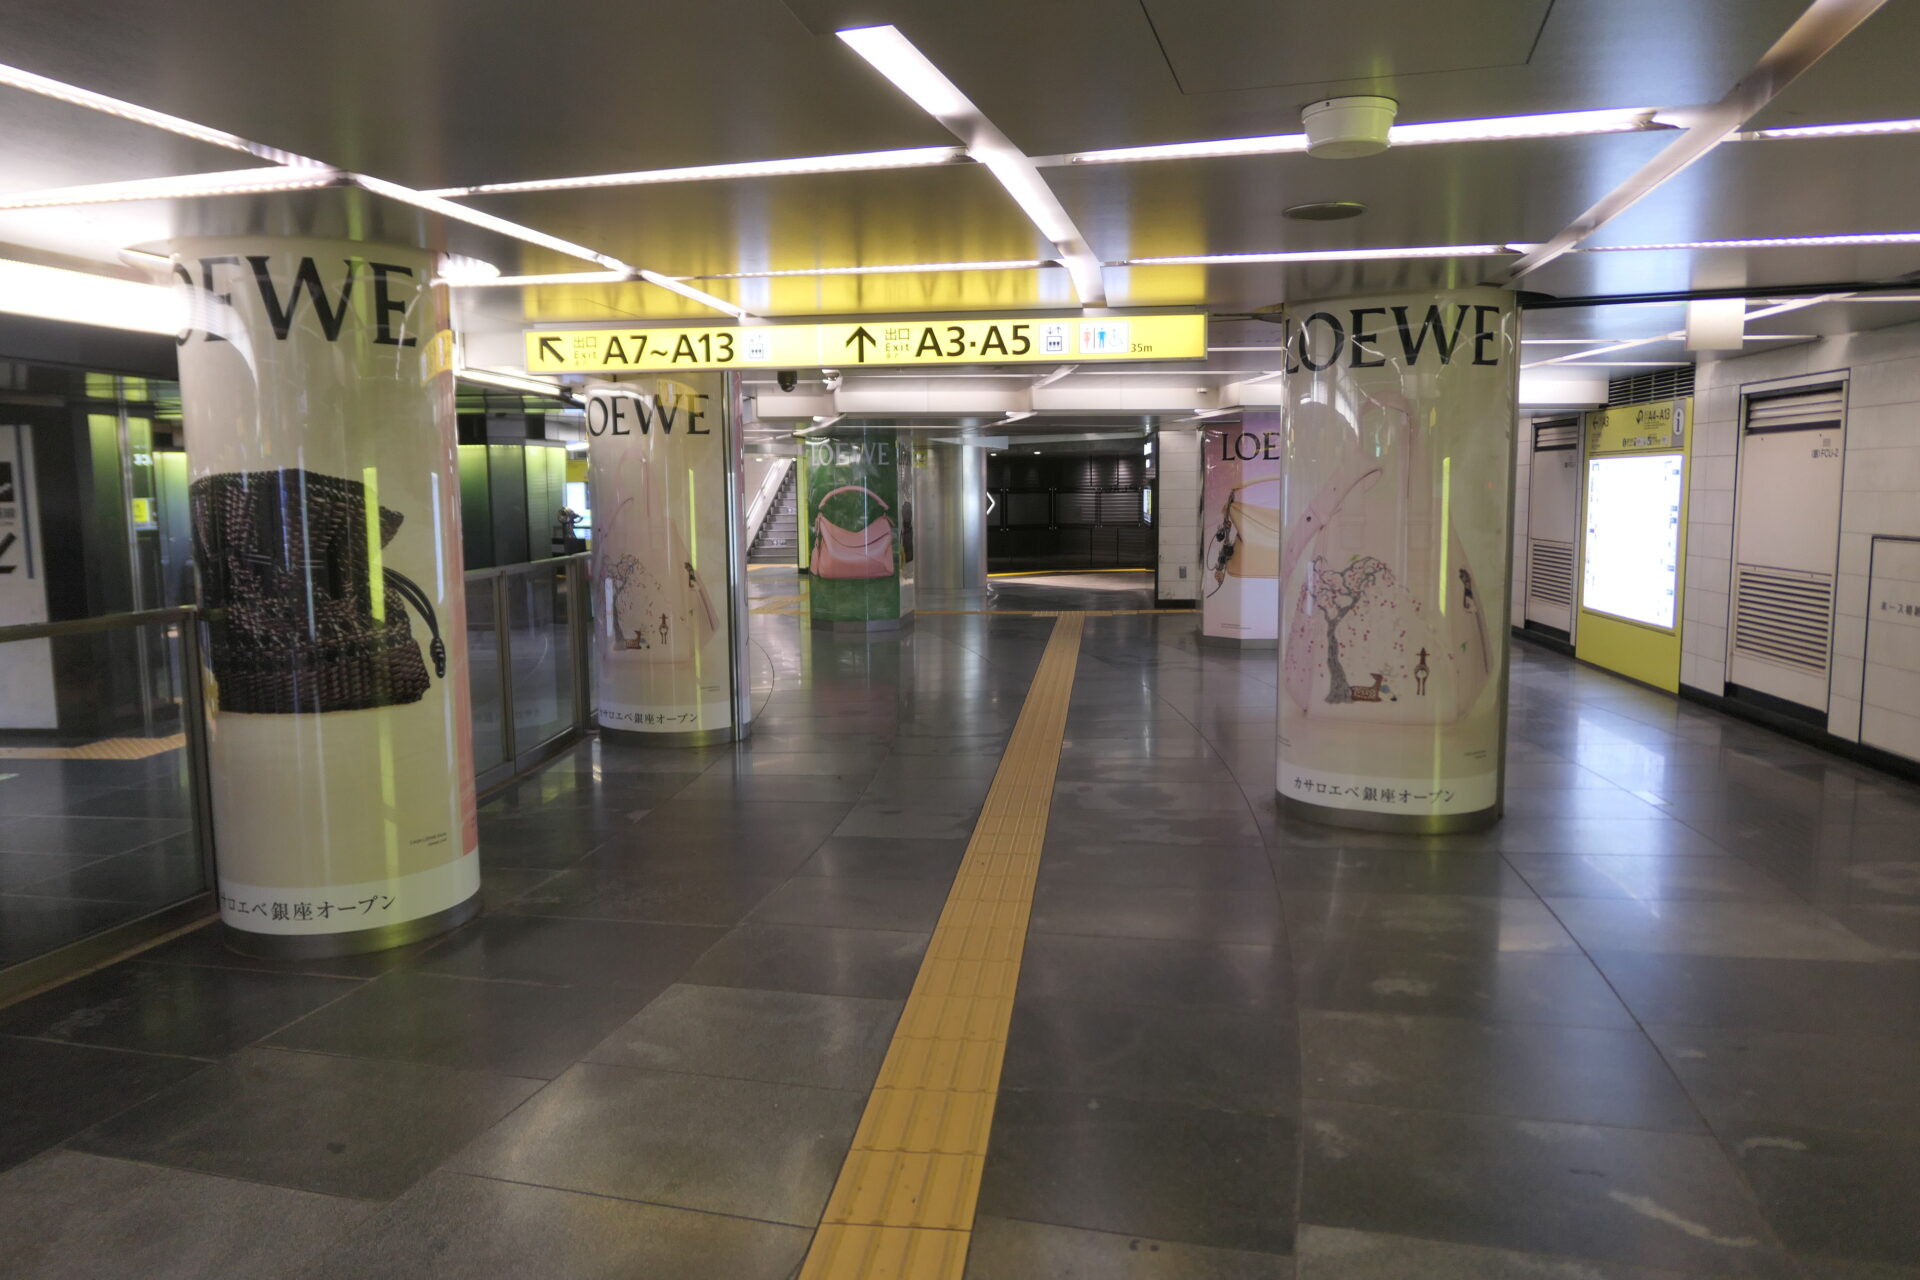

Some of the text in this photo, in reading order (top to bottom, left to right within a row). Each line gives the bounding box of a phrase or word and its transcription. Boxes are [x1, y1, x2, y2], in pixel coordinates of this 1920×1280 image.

[885, 328, 910, 341] 出口
[1285, 304, 1500, 374] LOEWE
[574, 336, 597, 348] 出口
[885, 342, 910, 352] Exit
[1130, 343, 1153, 353] 35m
[574, 351, 597, 359] Exit
[811, 442, 890, 466] LOEWE
[1293, 776, 1456, 804] カサロエベ銀座オープン
